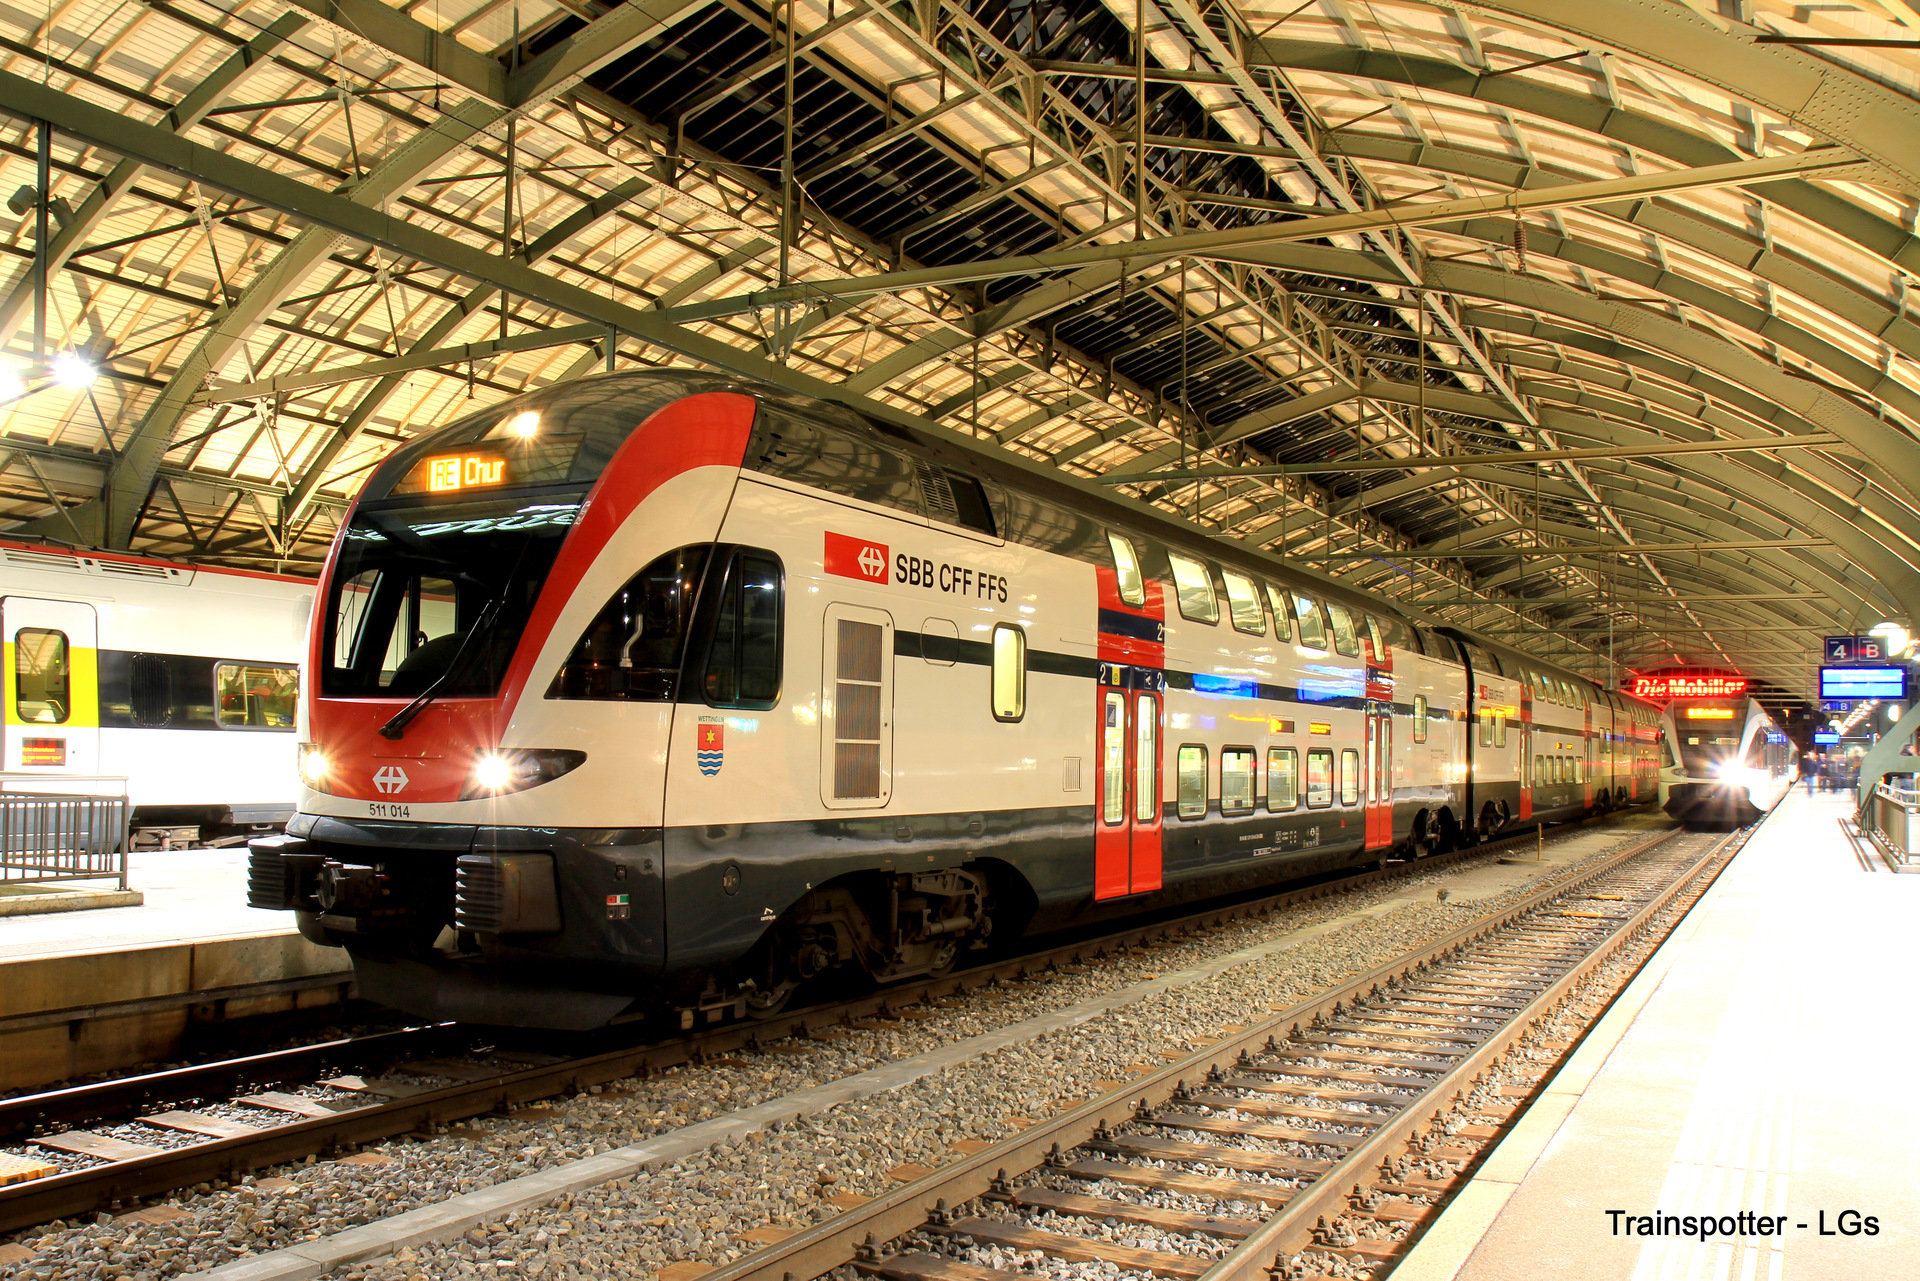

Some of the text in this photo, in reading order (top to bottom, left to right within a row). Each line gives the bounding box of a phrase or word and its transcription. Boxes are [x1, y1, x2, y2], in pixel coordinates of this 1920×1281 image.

[433, 457, 505, 489] RE Chur
[896, 553, 1008, 603] SBB CFF FFS
[1157, 622, 1163, 641] 2
[1833, 644, 1879, 658] 4 B
[1100, 663, 1163, 691] 2 2
[1635, 679, 1666, 696] Die
[1823, 702, 1848, 711] 4 B
[369, 803, 410, 818] 511 014
